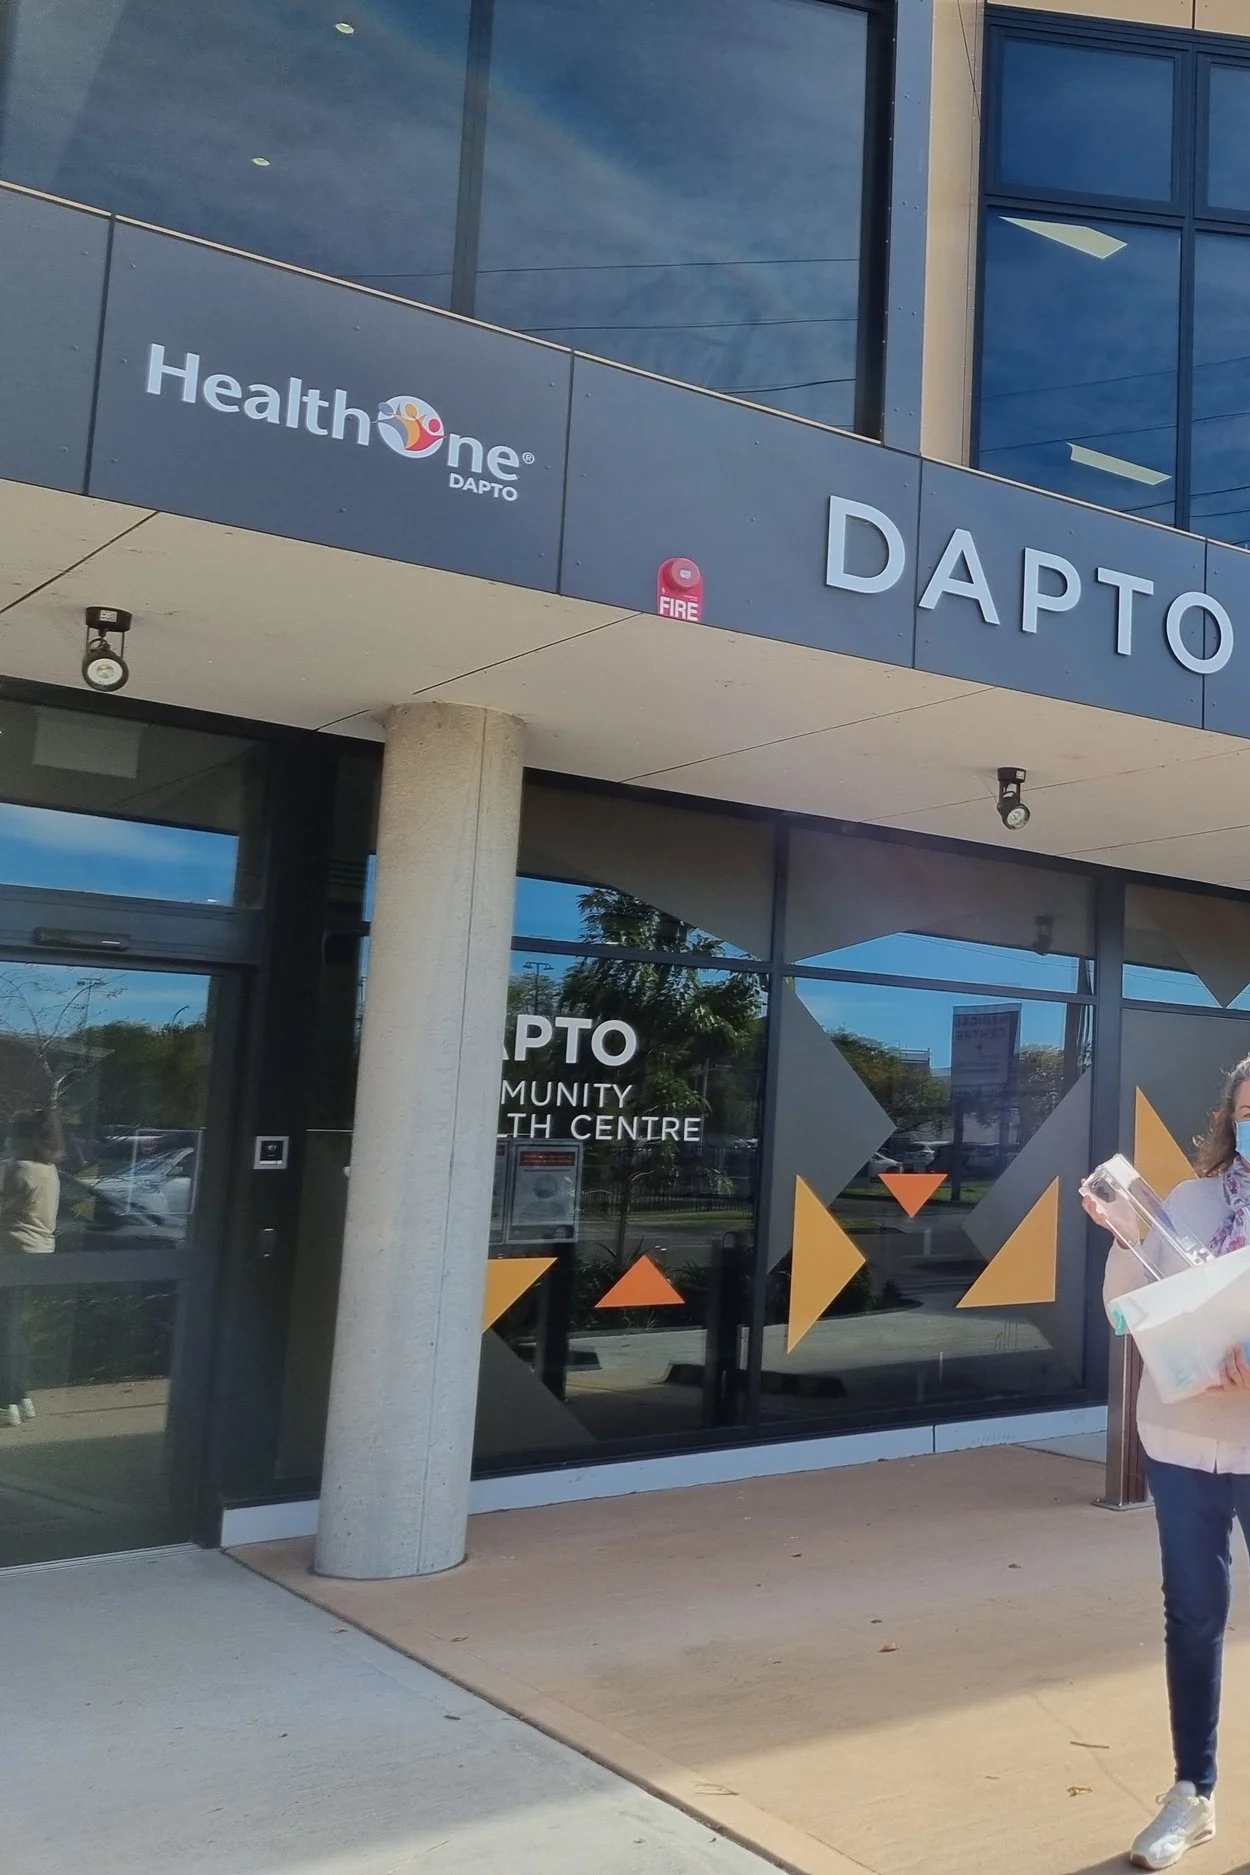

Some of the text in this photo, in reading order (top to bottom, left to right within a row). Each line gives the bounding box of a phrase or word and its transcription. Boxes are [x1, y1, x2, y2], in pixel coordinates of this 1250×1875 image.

[449, 473, 518, 501] DAPTO
[826, 495, 1234, 675] DAPTO
[659, 595, 699, 621] FIRE
[502, 1014, 638, 1067] PTO
[500, 1080, 633, 1108] MUNITY
[570, 1114, 702, 1142] CENTRE
